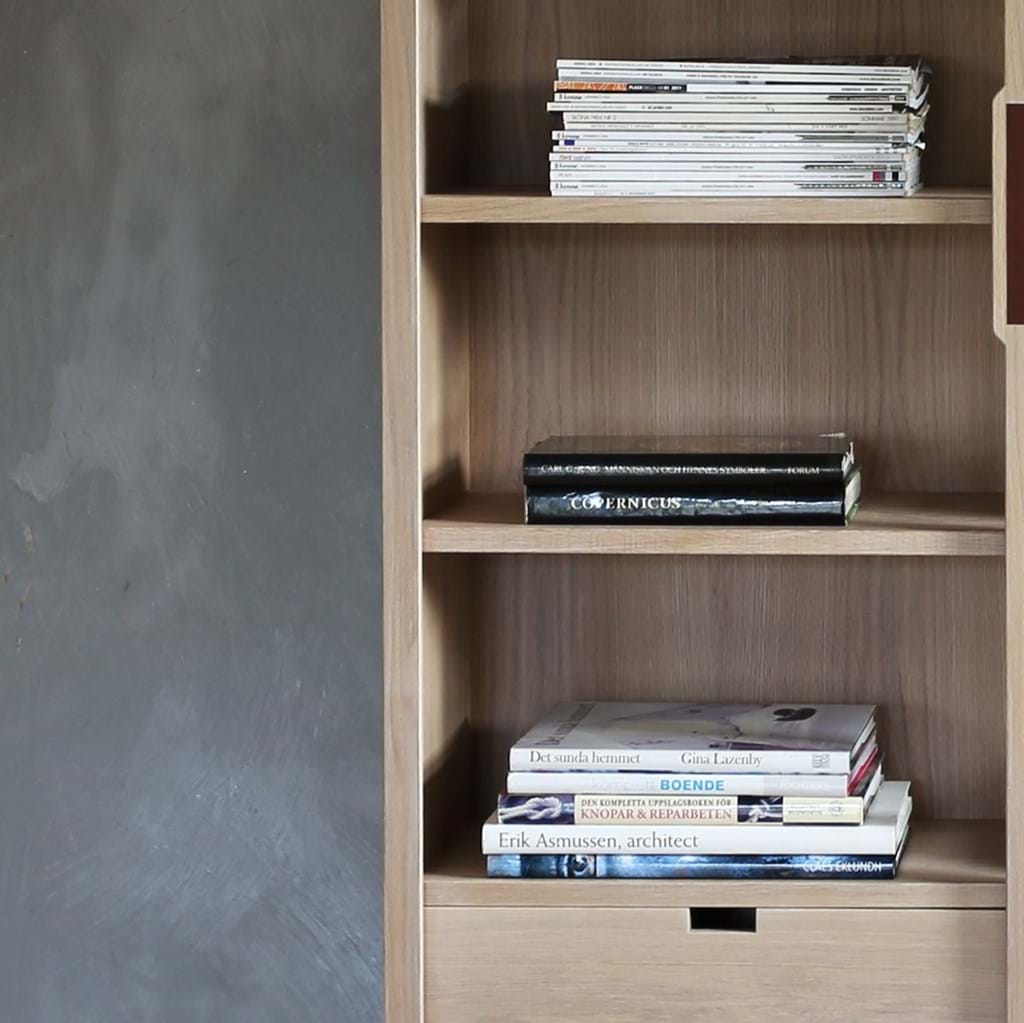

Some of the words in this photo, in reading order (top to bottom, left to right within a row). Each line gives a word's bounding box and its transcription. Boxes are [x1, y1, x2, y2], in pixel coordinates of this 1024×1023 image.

[541, 465, 563, 473] CARL
[787, 466, 820, 474] FORUM
[570, 496, 681, 510] COPERNICUS
[530, 750, 550, 763] Det
[555, 751, 589, 763] sunda
[592, 751, 640, 764] hemmet
[681, 752, 710, 765] Gina
[714, 753, 763, 767] Lazenby
[660, 779, 724, 791] BOENDE
[648, 799, 714, 807] UPPSLAGSBOKEN
[716, 798, 731, 807] FÖR
[581, 808, 634, 819] KNOPAR
[637, 809, 647, 819] &
[650, 808, 732, 819] REPARBETEN
[499, 832, 530, 848] Erik
[536, 832, 621, 850] Asmussen,
[627, 832, 698, 848] architect
[835, 860, 882, 872] EKLUNDH
